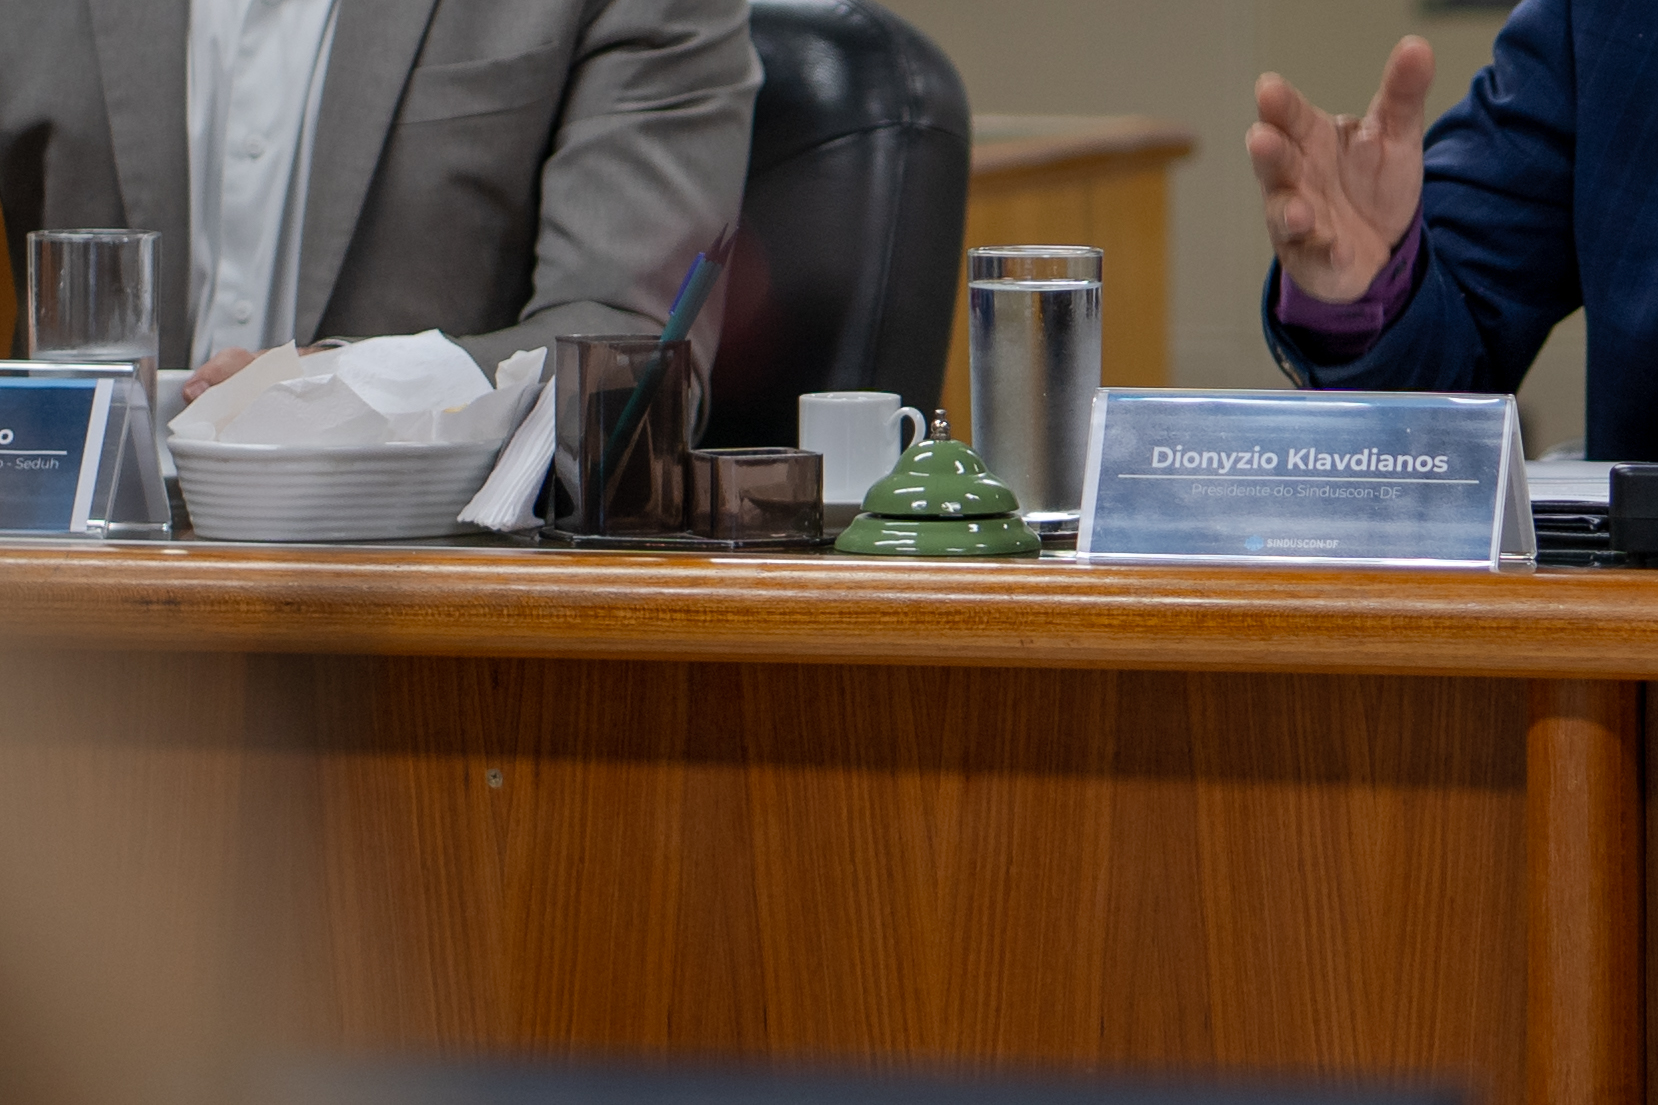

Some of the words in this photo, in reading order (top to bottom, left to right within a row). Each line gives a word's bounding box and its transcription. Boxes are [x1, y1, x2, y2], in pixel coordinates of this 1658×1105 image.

[15, 457, 60, 470] Seduh
[1151, 445, 1279, 474] Dionyzio
[1286, 448, 1449, 473] Klavdianos
[1192, 484, 1269, 496] Presidente
[1274, 485, 1293, 496] do
[1297, 484, 1401, 499] Sinduscon-DF
